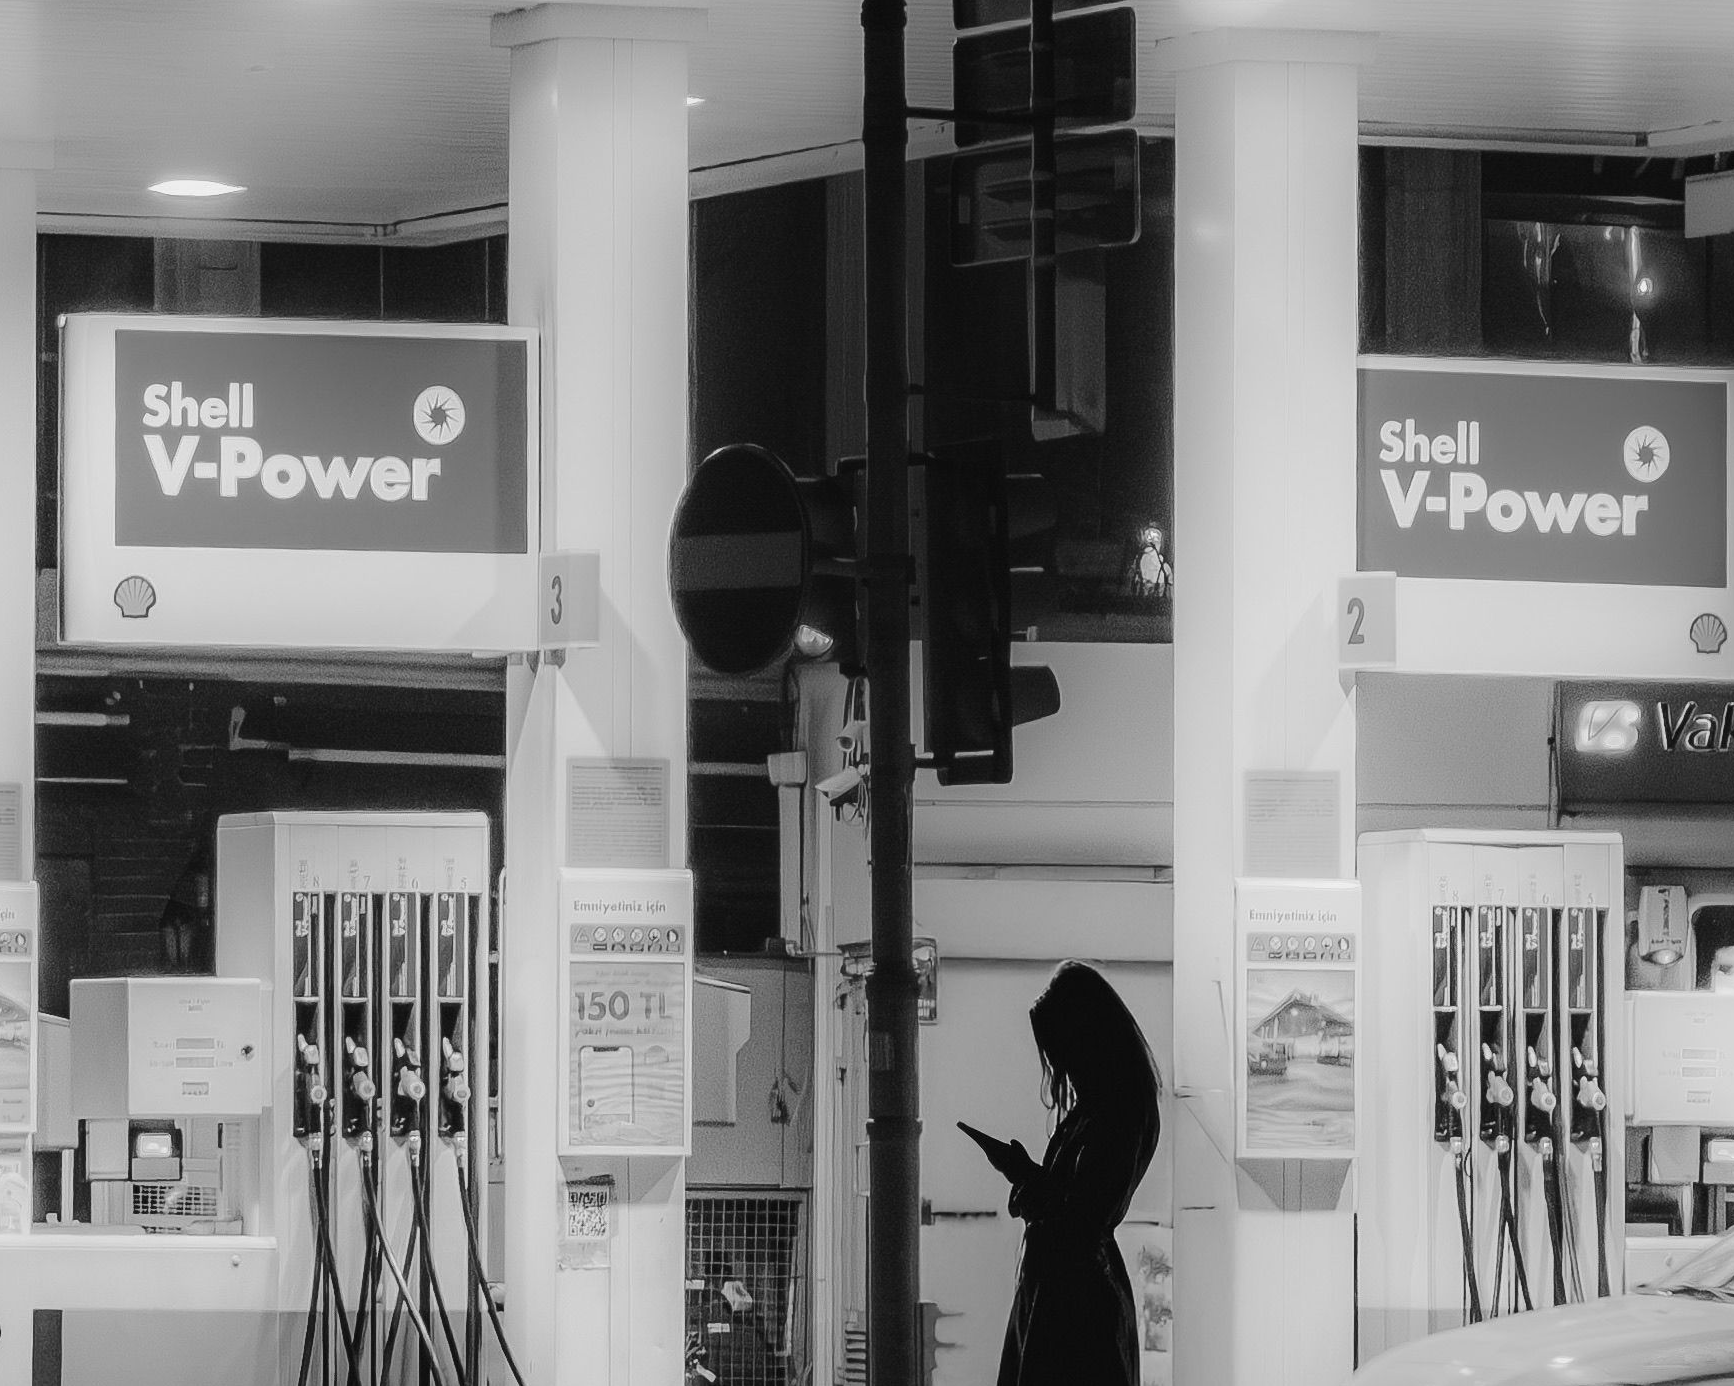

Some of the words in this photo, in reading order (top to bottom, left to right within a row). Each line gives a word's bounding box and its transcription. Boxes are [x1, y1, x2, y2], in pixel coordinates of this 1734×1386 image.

[142, 380, 255, 429] Shell
[1378, 419, 1480, 465] Shell
[142, 434, 442, 502] V-Power
[1378, 469, 1650, 537] V-Power
[549, 574, 563, 626] 3
[1346, 596, 1366, 646] 2
[574, 990, 630, 1021] 150
[639, 991, 673, 1020] TL
